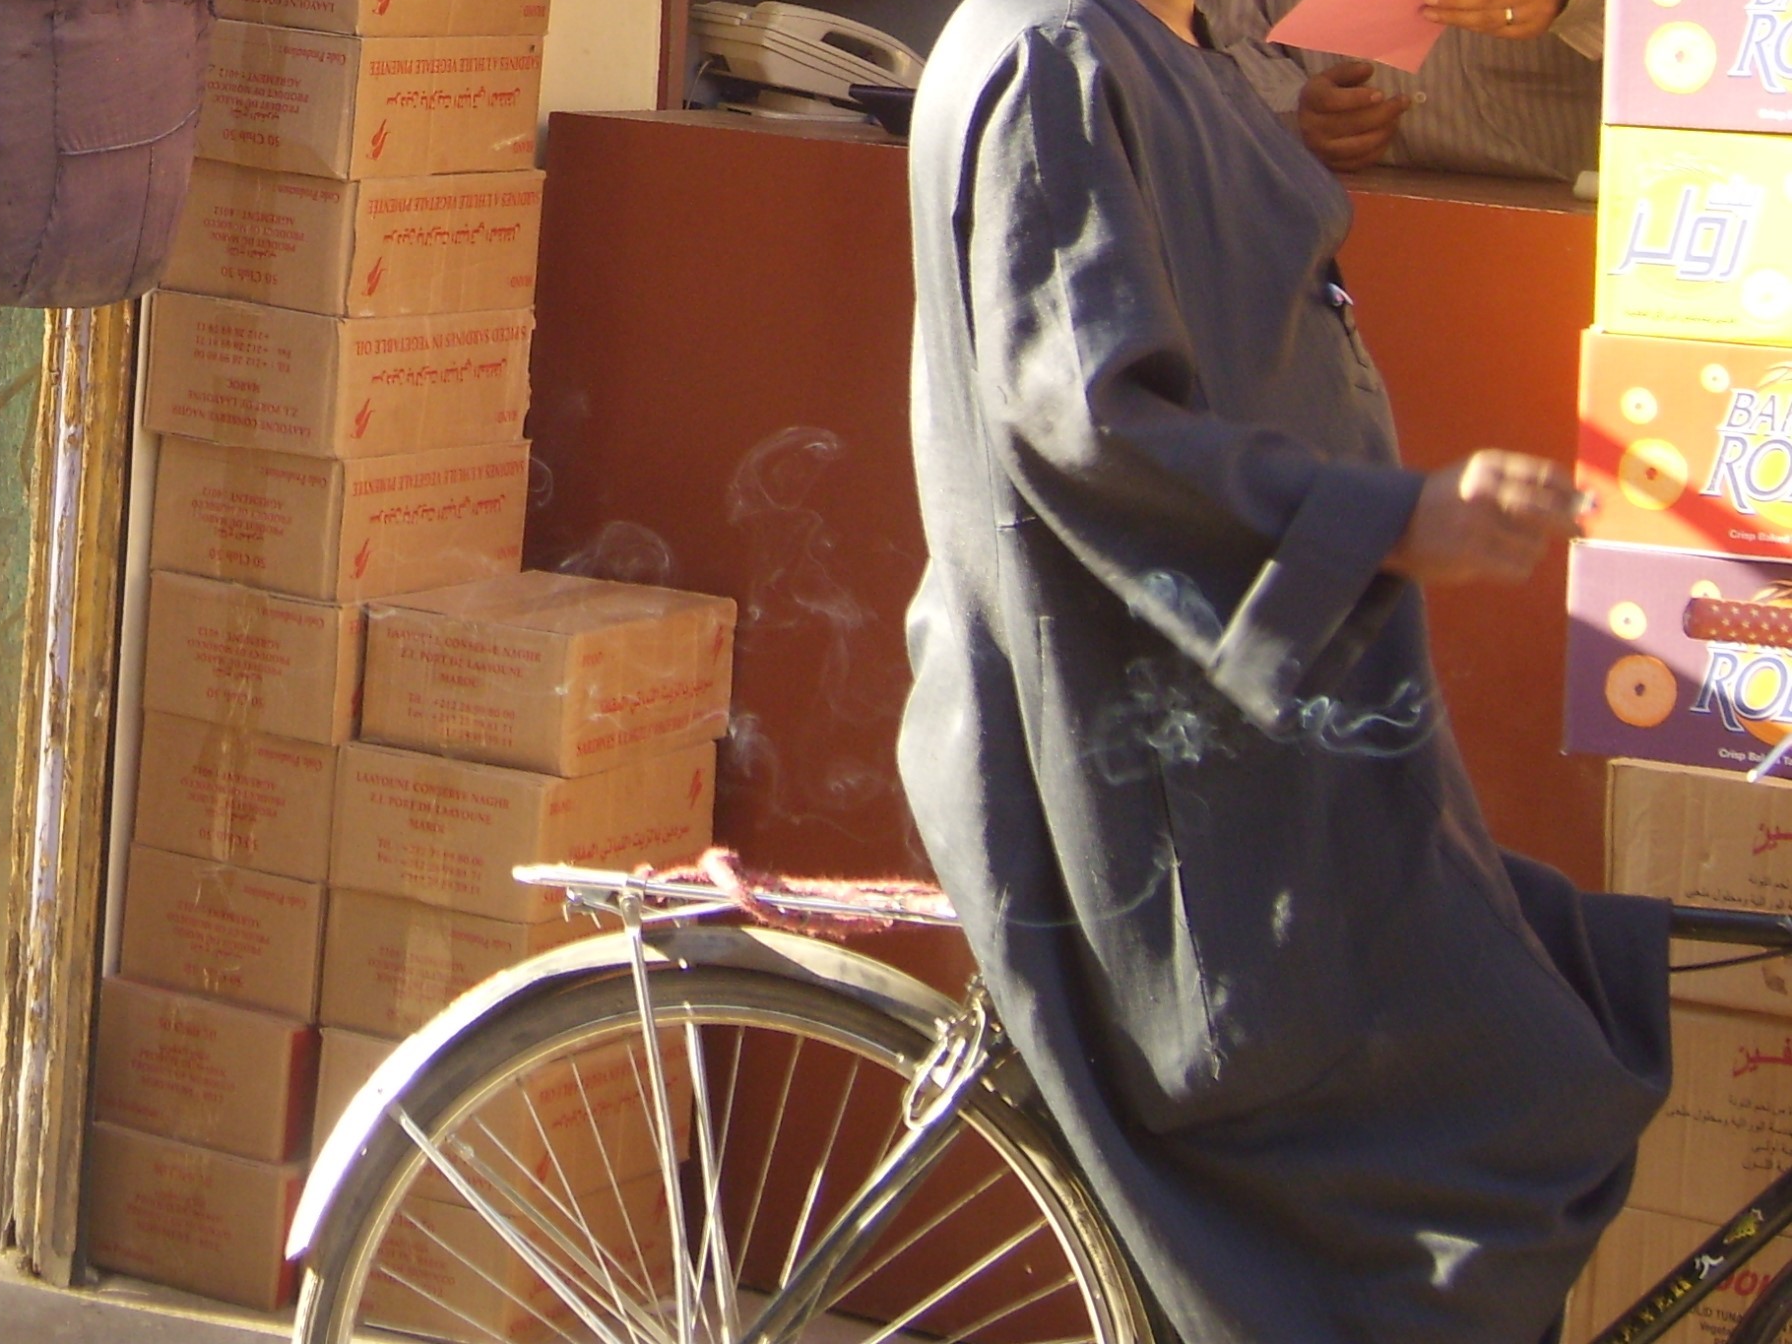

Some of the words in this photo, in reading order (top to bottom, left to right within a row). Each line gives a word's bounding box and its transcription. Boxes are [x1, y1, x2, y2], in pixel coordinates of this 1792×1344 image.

[374, 336, 430, 355] VEGETABLE
[444, 329, 489, 347] SARDINES
[355, 340, 372, 357] OIL
[1725, 392, 1792, 434] BA
[1704, 434, 1792, 512] RO
[1718, 748, 1746, 762] Crisp
